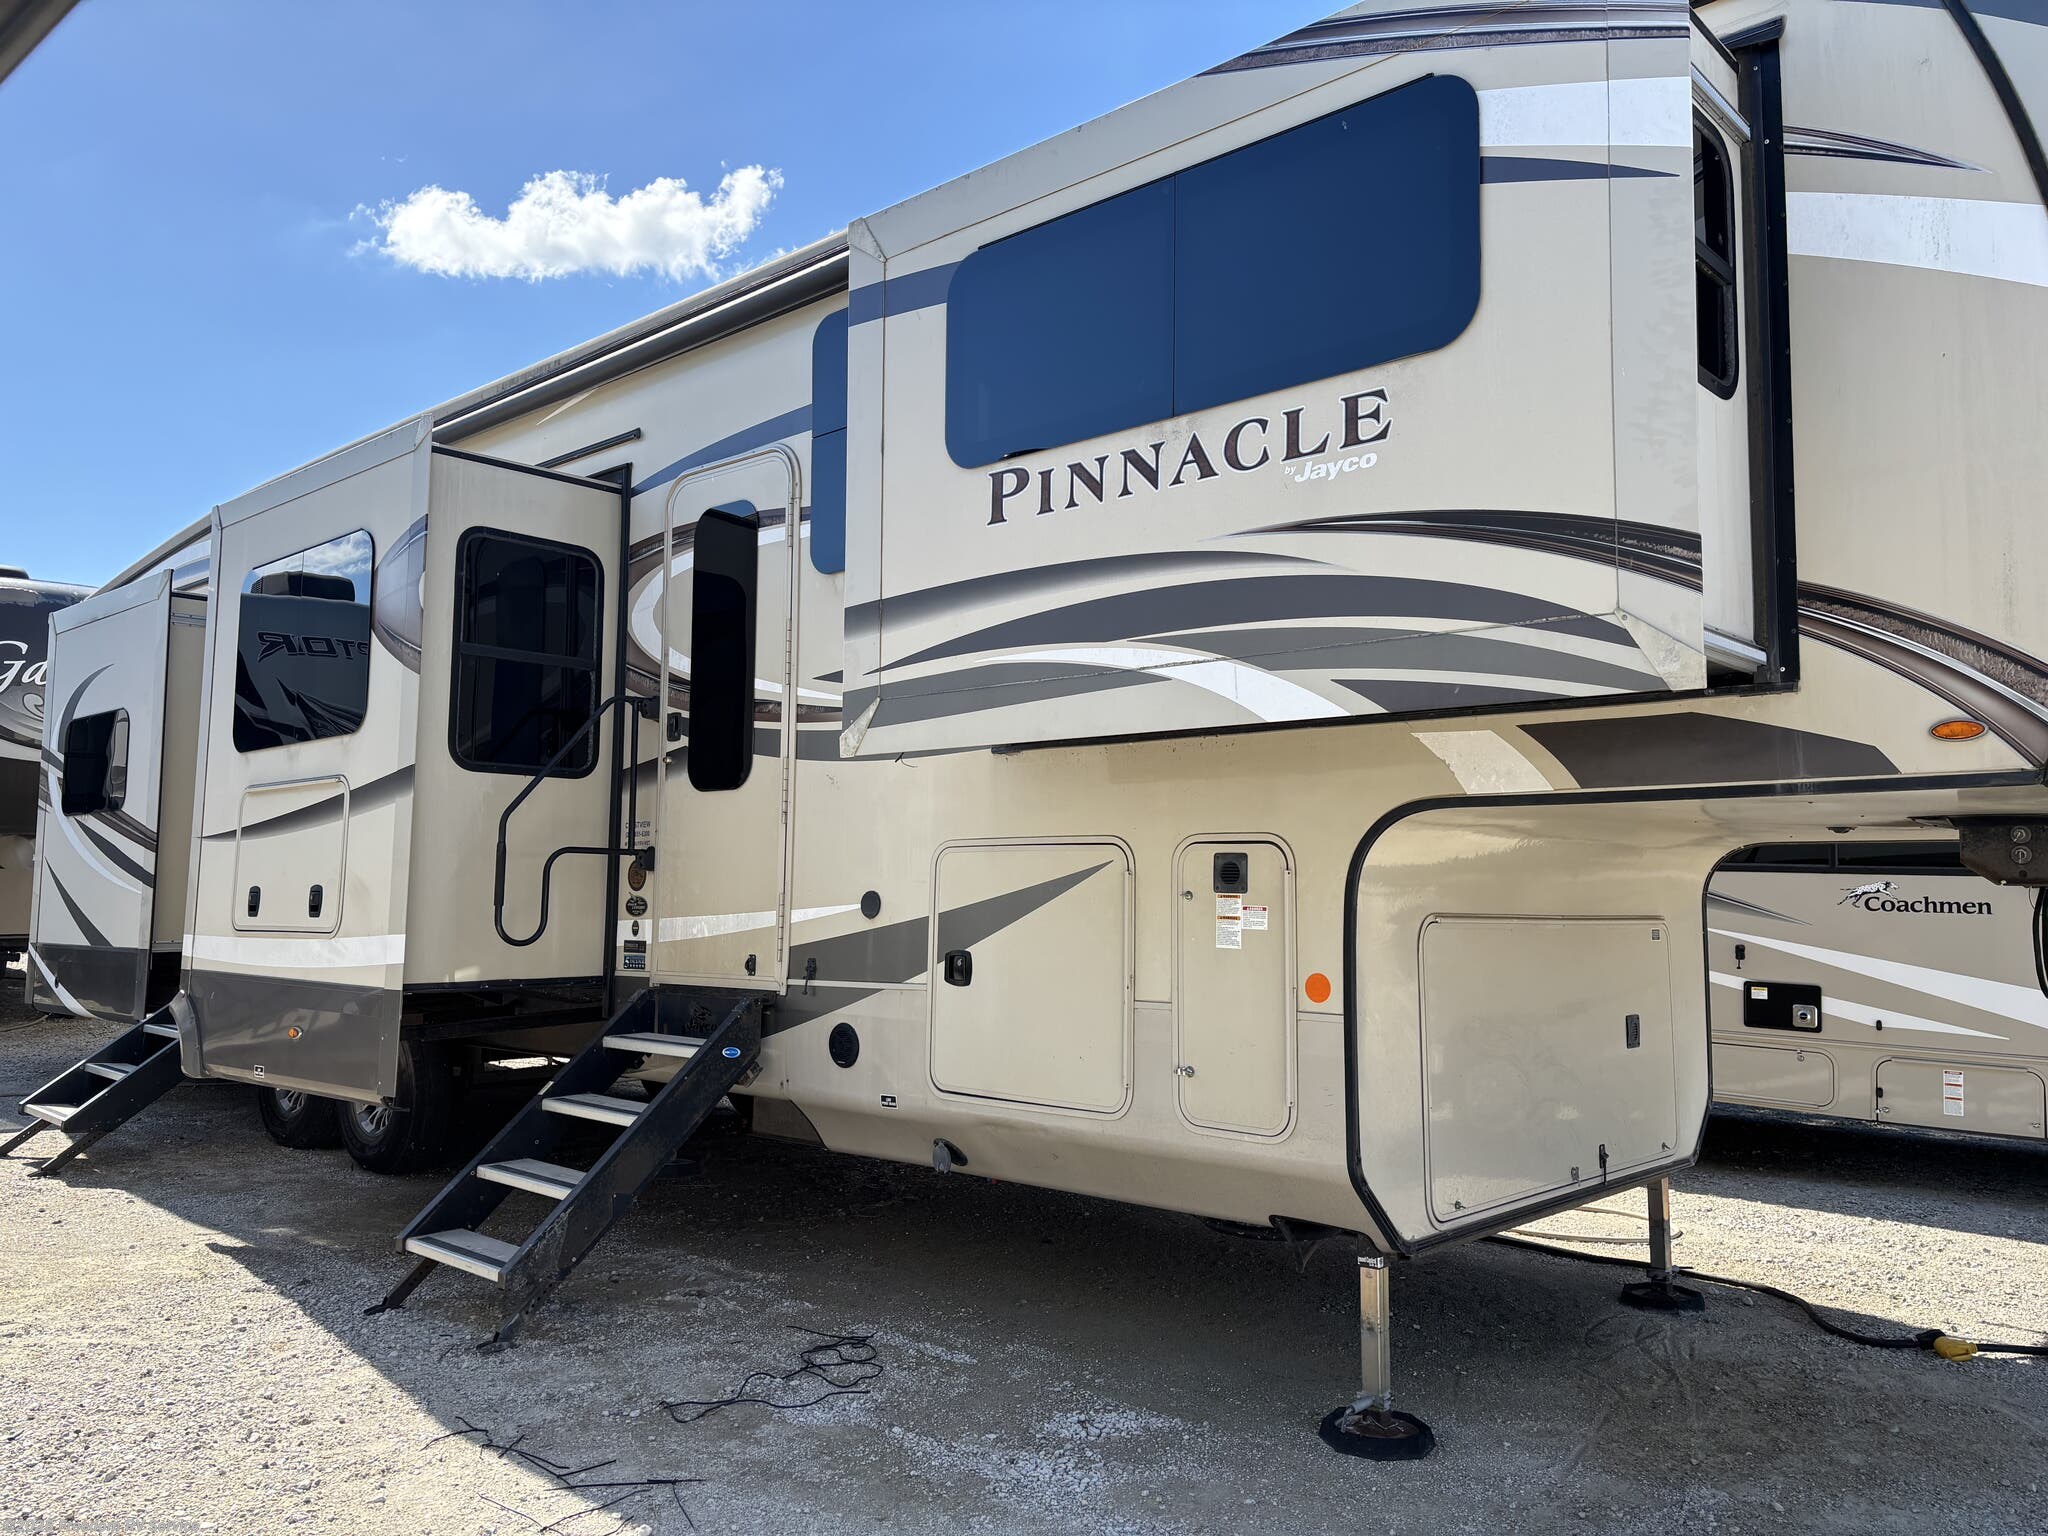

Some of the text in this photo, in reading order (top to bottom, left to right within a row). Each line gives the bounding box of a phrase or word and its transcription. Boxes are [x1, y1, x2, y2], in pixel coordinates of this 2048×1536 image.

[986, 387, 1392, 526] PINNACLE
[1284, 453, 1378, 482] by Jayco
[1864, 896, 1992, 914] Coachmen
